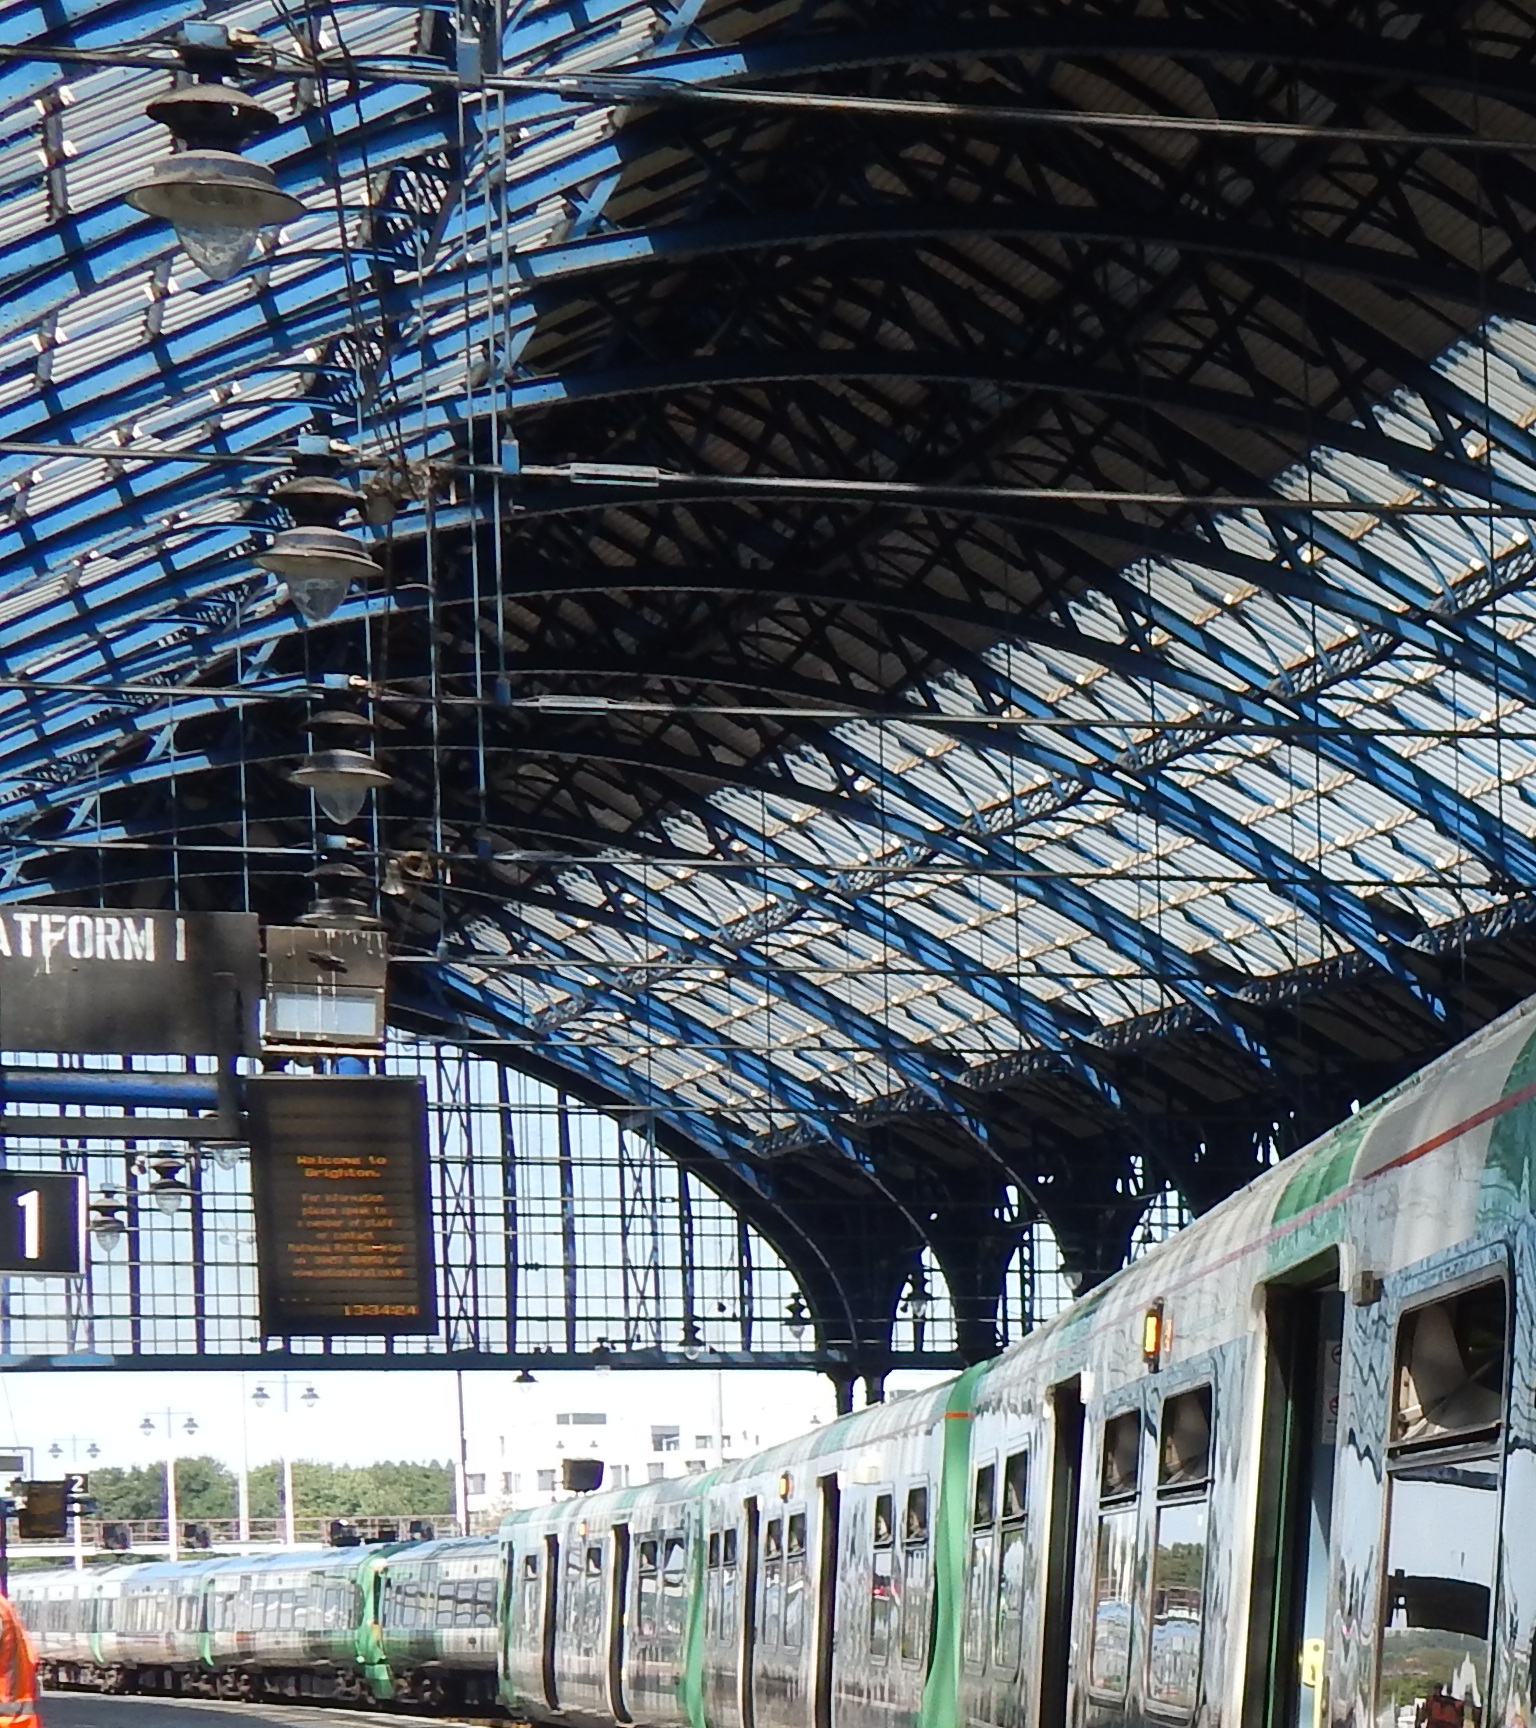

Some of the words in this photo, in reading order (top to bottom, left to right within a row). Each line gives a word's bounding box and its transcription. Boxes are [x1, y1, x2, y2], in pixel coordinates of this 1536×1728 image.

[296, 1155, 361, 1165] Welcome
[368, 1155, 388, 1165] to
[17, 1189, 39, 1260] 1
[344, 1304, 419, 1316] 13:34:24
[71, 1475, 85, 1493] 2
